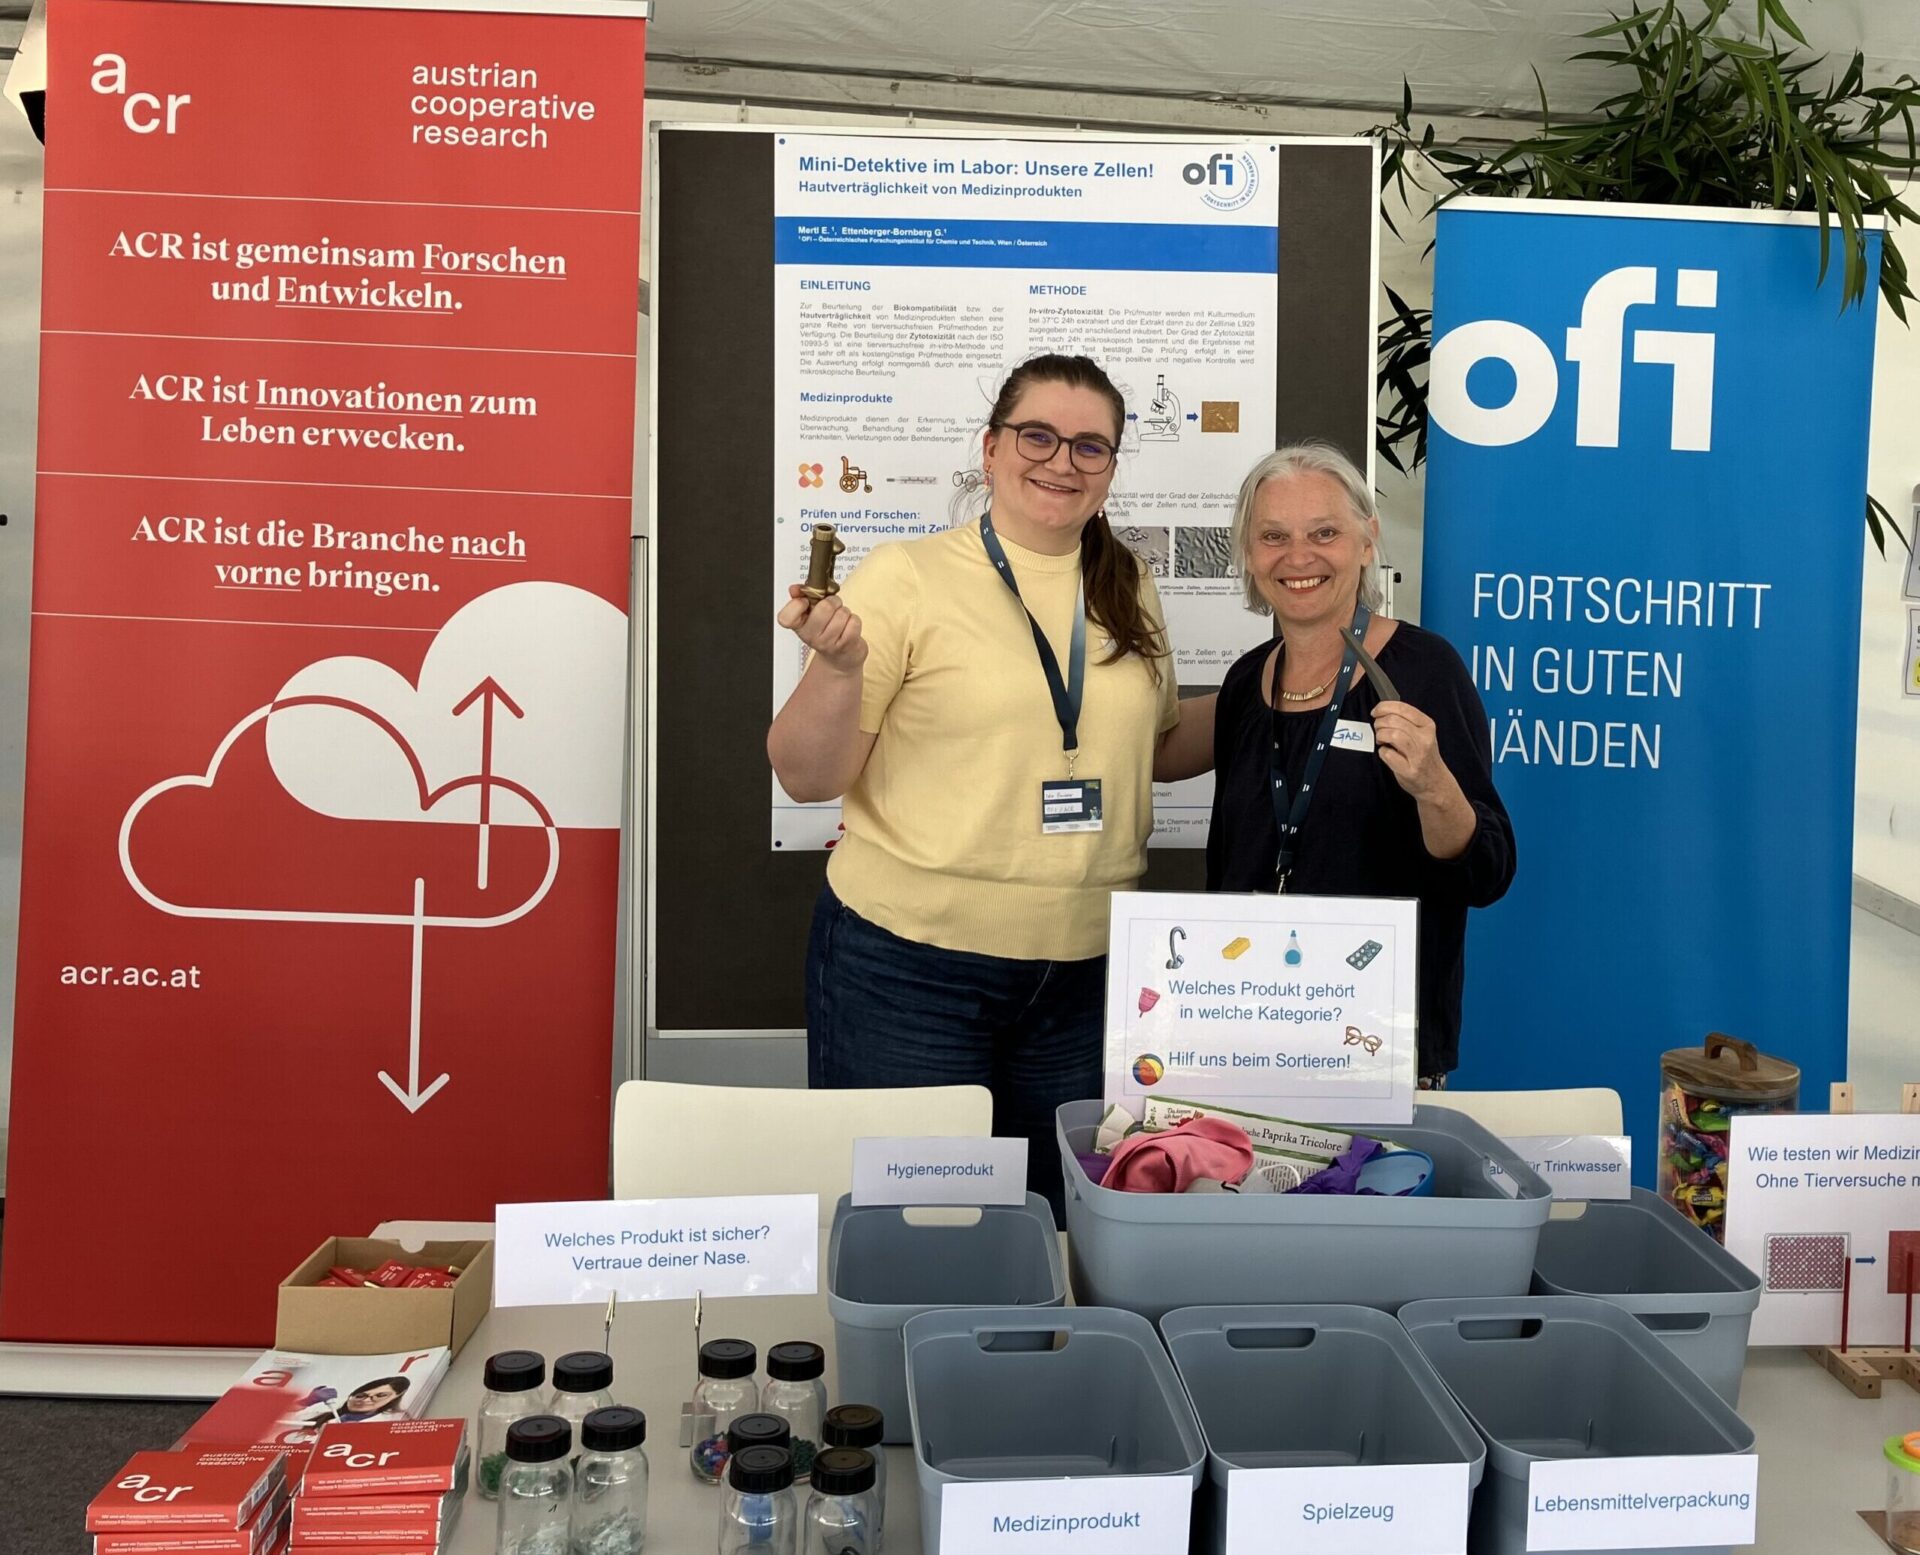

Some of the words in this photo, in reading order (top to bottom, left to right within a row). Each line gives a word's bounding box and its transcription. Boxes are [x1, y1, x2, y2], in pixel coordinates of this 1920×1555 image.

[412, 63, 537, 89] austrian
[91, 53, 190, 134] acr
[411, 93, 595, 123] cooperative
[413, 122, 548, 149] research
[799, 156, 928, 173] Mini-Detektive
[934, 159, 955, 174] im
[961, 159, 1018, 175] Labor:
[1025, 161, 1088, 176] Unsere
[1093, 162, 1154, 178] Zellen!
[1182, 153, 1233, 186] ofi
[799, 181, 928, 196] Hautverträglichkeit
[932, 186, 957, 195] von
[962, 183, 1082, 198] Medizinprodukten
[842, 227, 933, 238] Ettenberger-Bornberg
[109, 233, 184, 259] ACR
[193, 235, 231, 261] ist
[237, 238, 415, 269] gemeinsam
[422, 244, 566, 274] Forschen
[211, 276, 269, 301] und
[277, 278, 463, 309] Entwickeln.
[800, 281, 871, 291] EINLEITUNG
[1030, 286, 1087, 295] METHODE
[800, 312, 871, 320] Hautverträglichkeit
[894, 314, 955, 322] Medizinprodukten
[822, 303, 862, 311] Beurteilung
[894, 304, 957, 312] Biokompatibilität
[854, 332, 894, 340] Beurteilung
[1428, 266, 1718, 452] ofi
[129, 376, 205, 402] ACR
[213, 378, 250, 404] ist
[257, 380, 462, 413] Innovationen
[470, 395, 537, 415] zum
[800, 393, 893, 404] Medizinprodukte
[202, 416, 296, 445] Leben
[303, 422, 465, 452] erwecken.
[846, 434, 891, 442] Verletzungen
[863, 425, 904, 433] Behandlung
[801, 509, 836, 519] Prüfen
[840, 510, 861, 519] und
[865, 510, 920, 520] Forschen:
[132, 517, 207, 543] ACR
[215, 518, 252, 545] ist
[257, 519, 304, 547] die
[313, 523, 444, 554] Branche
[451, 531, 526, 556] nach
[834, 524, 905, 533] Tierversuche
[909, 524, 925, 533] mit
[215, 564, 301, 586] vorne
[308, 563, 440, 595] bringen.
[1474, 573, 1771, 629] FORTSCHRITT
[1471, 645, 1514, 691] IN
[1532, 647, 1683, 698] GUTEN
[1333, 728, 1363, 743] GABI
[61, 966, 200, 988] acr.ac.at
[1169, 980, 1235, 996] Welches
[1241, 982, 1301, 997] Produkt
[1306, 984, 1354, 1000] gehört
[1180, 1006, 1192, 1019] in
[1198, 1006, 1252, 1020] welche
[1259, 1006, 1342, 1024] Kategorie?
[1169, 1051, 1195, 1066] Hilf
[1200, 1053, 1227, 1067] uns
[1233, 1053, 1270, 1068] beim
[1275, 1053, 1351, 1069] Sortieren!
[1262, 1128, 1297, 1144] Paprika
[1300, 1135, 1342, 1151] Tricolore
[1749, 1146, 1777, 1161] Wie
[1784, 1147, 1830, 1161] testen
[1836, 1146, 1858, 1160] wir
[887, 1162, 994, 1179] Hygieneprodukt
[1544, 1160, 1621, 1172] Trinkwasser
[1757, 1173, 1798, 1188] Ohne
[1805, 1172, 1906, 1187] Tierversuche
[545, 1233, 615, 1247] Welches
[621, 1229, 684, 1245] Produkt
[689, 1228, 707, 1242] ist
[712, 1225, 769, 1241] sicher?
[572, 1256, 642, 1270] Vertraue
[648, 1253, 698, 1268] deiner
[704, 1251, 750, 1265] Nase.
[323, 1444, 399, 1468] acr
[117, 1474, 194, 1502] acr
[1534, 1491, 1750, 1512] Lebensmittelverpackung
[1303, 1502, 1394, 1522] Spielzeug
[993, 1512, 1140, 1534] Medizinprodukt
